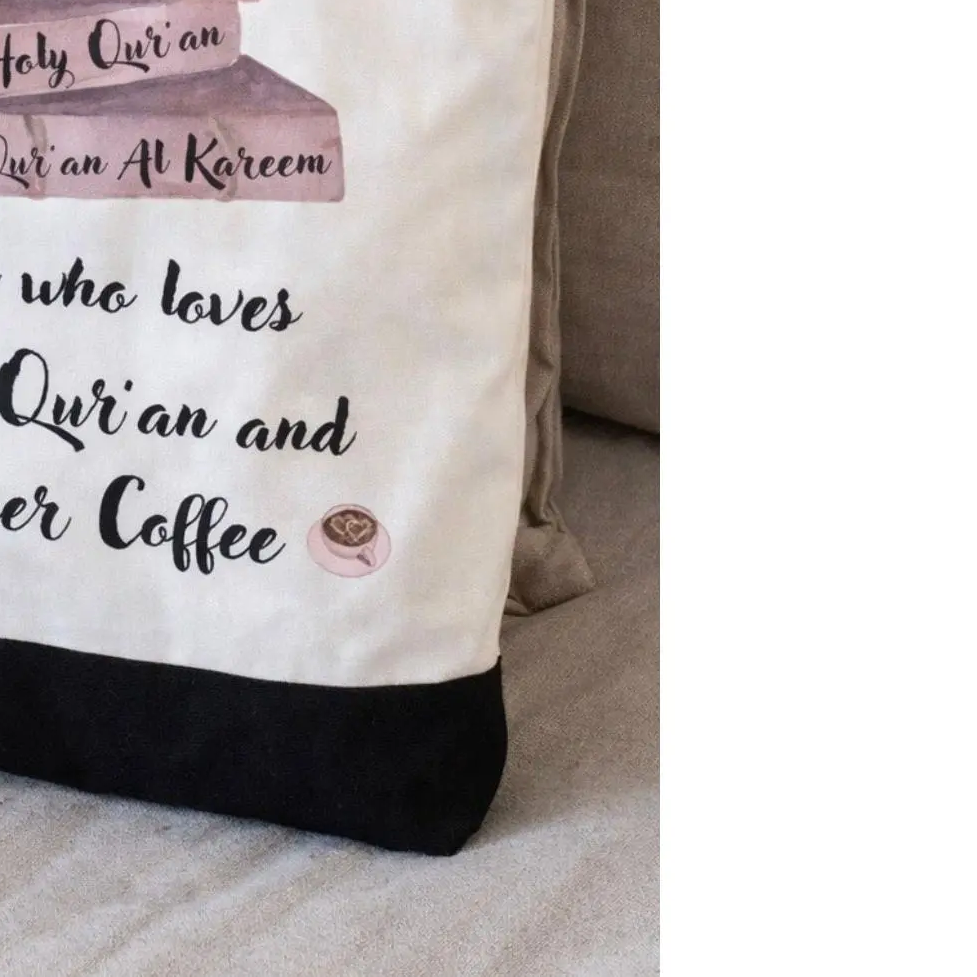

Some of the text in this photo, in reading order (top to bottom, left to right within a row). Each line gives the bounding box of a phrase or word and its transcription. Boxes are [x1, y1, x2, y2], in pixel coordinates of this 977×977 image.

[117, 138, 171, 190] Al
[184, 132, 333, 191] Kareem
[21, 257, 139, 313] who
[161, 259, 304, 333] loves
[236, 396, 357, 456] and
[98, 474, 287, 575] Coffee
